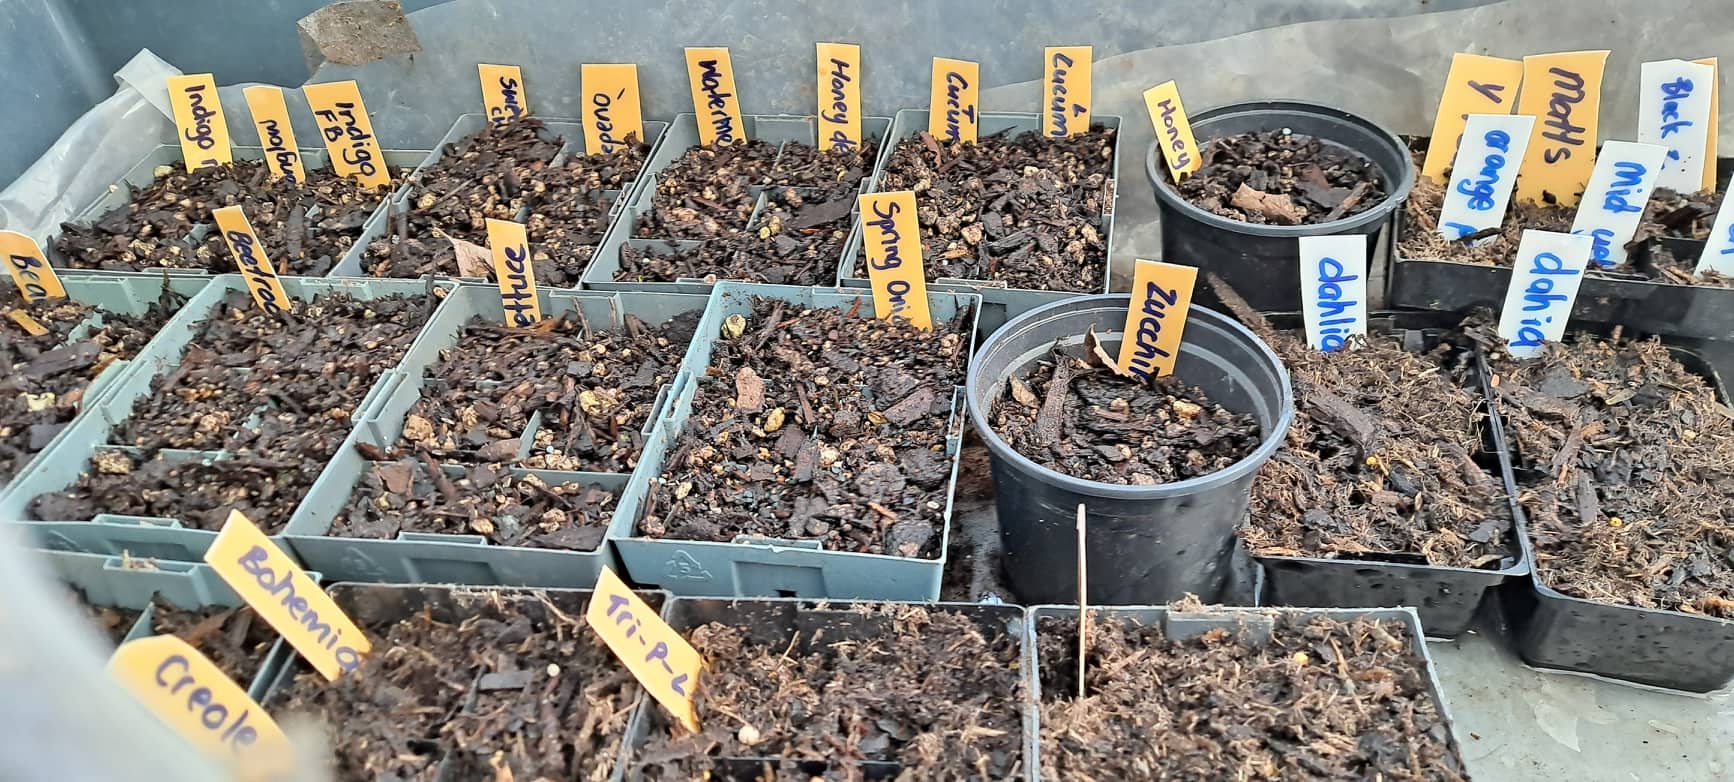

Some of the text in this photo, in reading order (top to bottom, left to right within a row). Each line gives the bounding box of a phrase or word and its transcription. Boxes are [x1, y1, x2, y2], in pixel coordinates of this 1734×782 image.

[184, 84, 217, 150] Indigo
[821, 58, 851, 124] Honey
[335, 102, 376, 177] Indigo
[1157, 98, 1190, 169] Honey
[1456, 130, 1511, 211] orange
[866, 200, 903, 270] Spring
[501, 243, 536, 327] ettuce
[1315, 257, 1358, 352] dahlia
[237, 544, 362, 672] Bohemia
[155, 654, 258, 751] Creole
